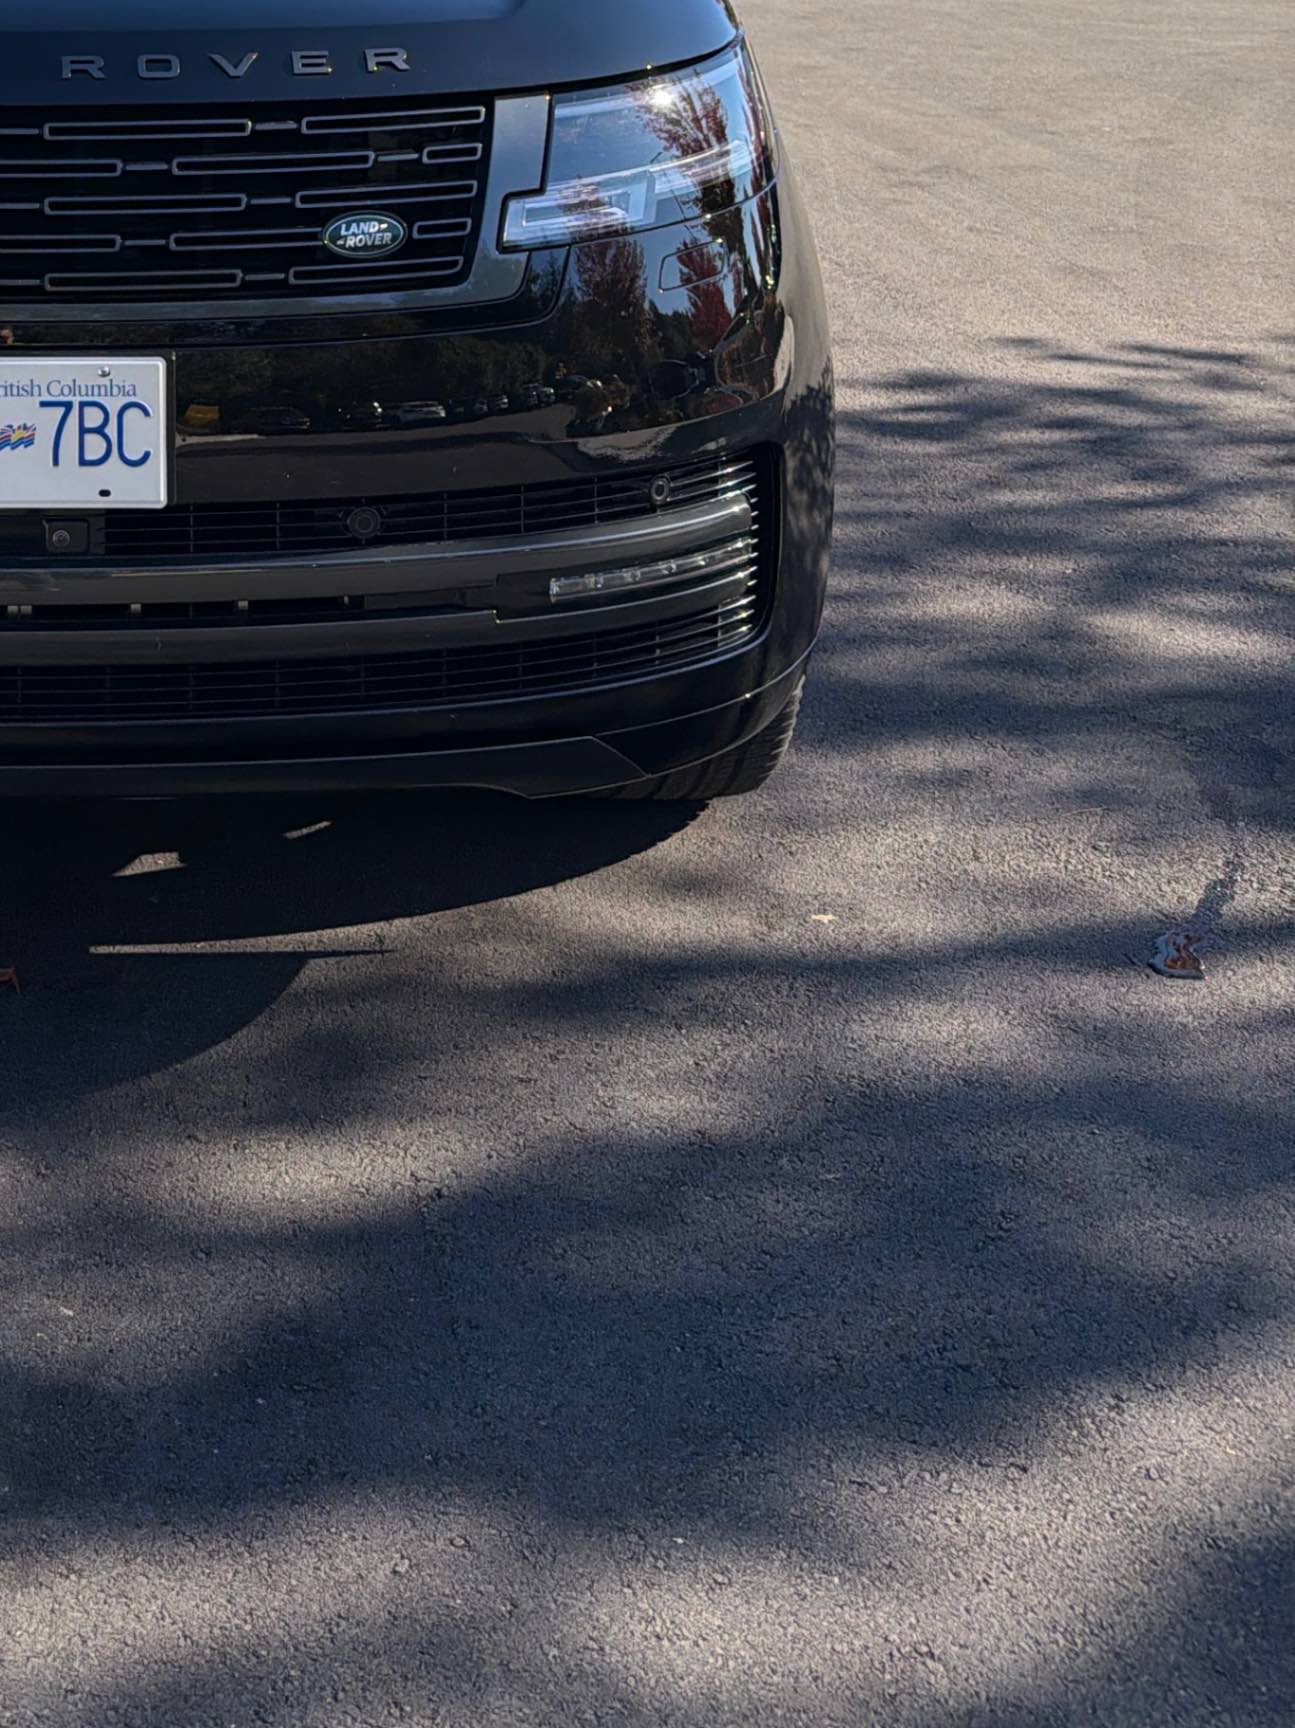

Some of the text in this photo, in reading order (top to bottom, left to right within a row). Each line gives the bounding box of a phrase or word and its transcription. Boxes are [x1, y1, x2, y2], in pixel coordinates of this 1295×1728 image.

[61, 47, 411, 79] ROVER
[340, 221, 379, 236] LAND
[345, 232, 392, 248] ROVER
[46, 379, 137, 397] Columbia
[39, 400, 152, 467] 7BC
